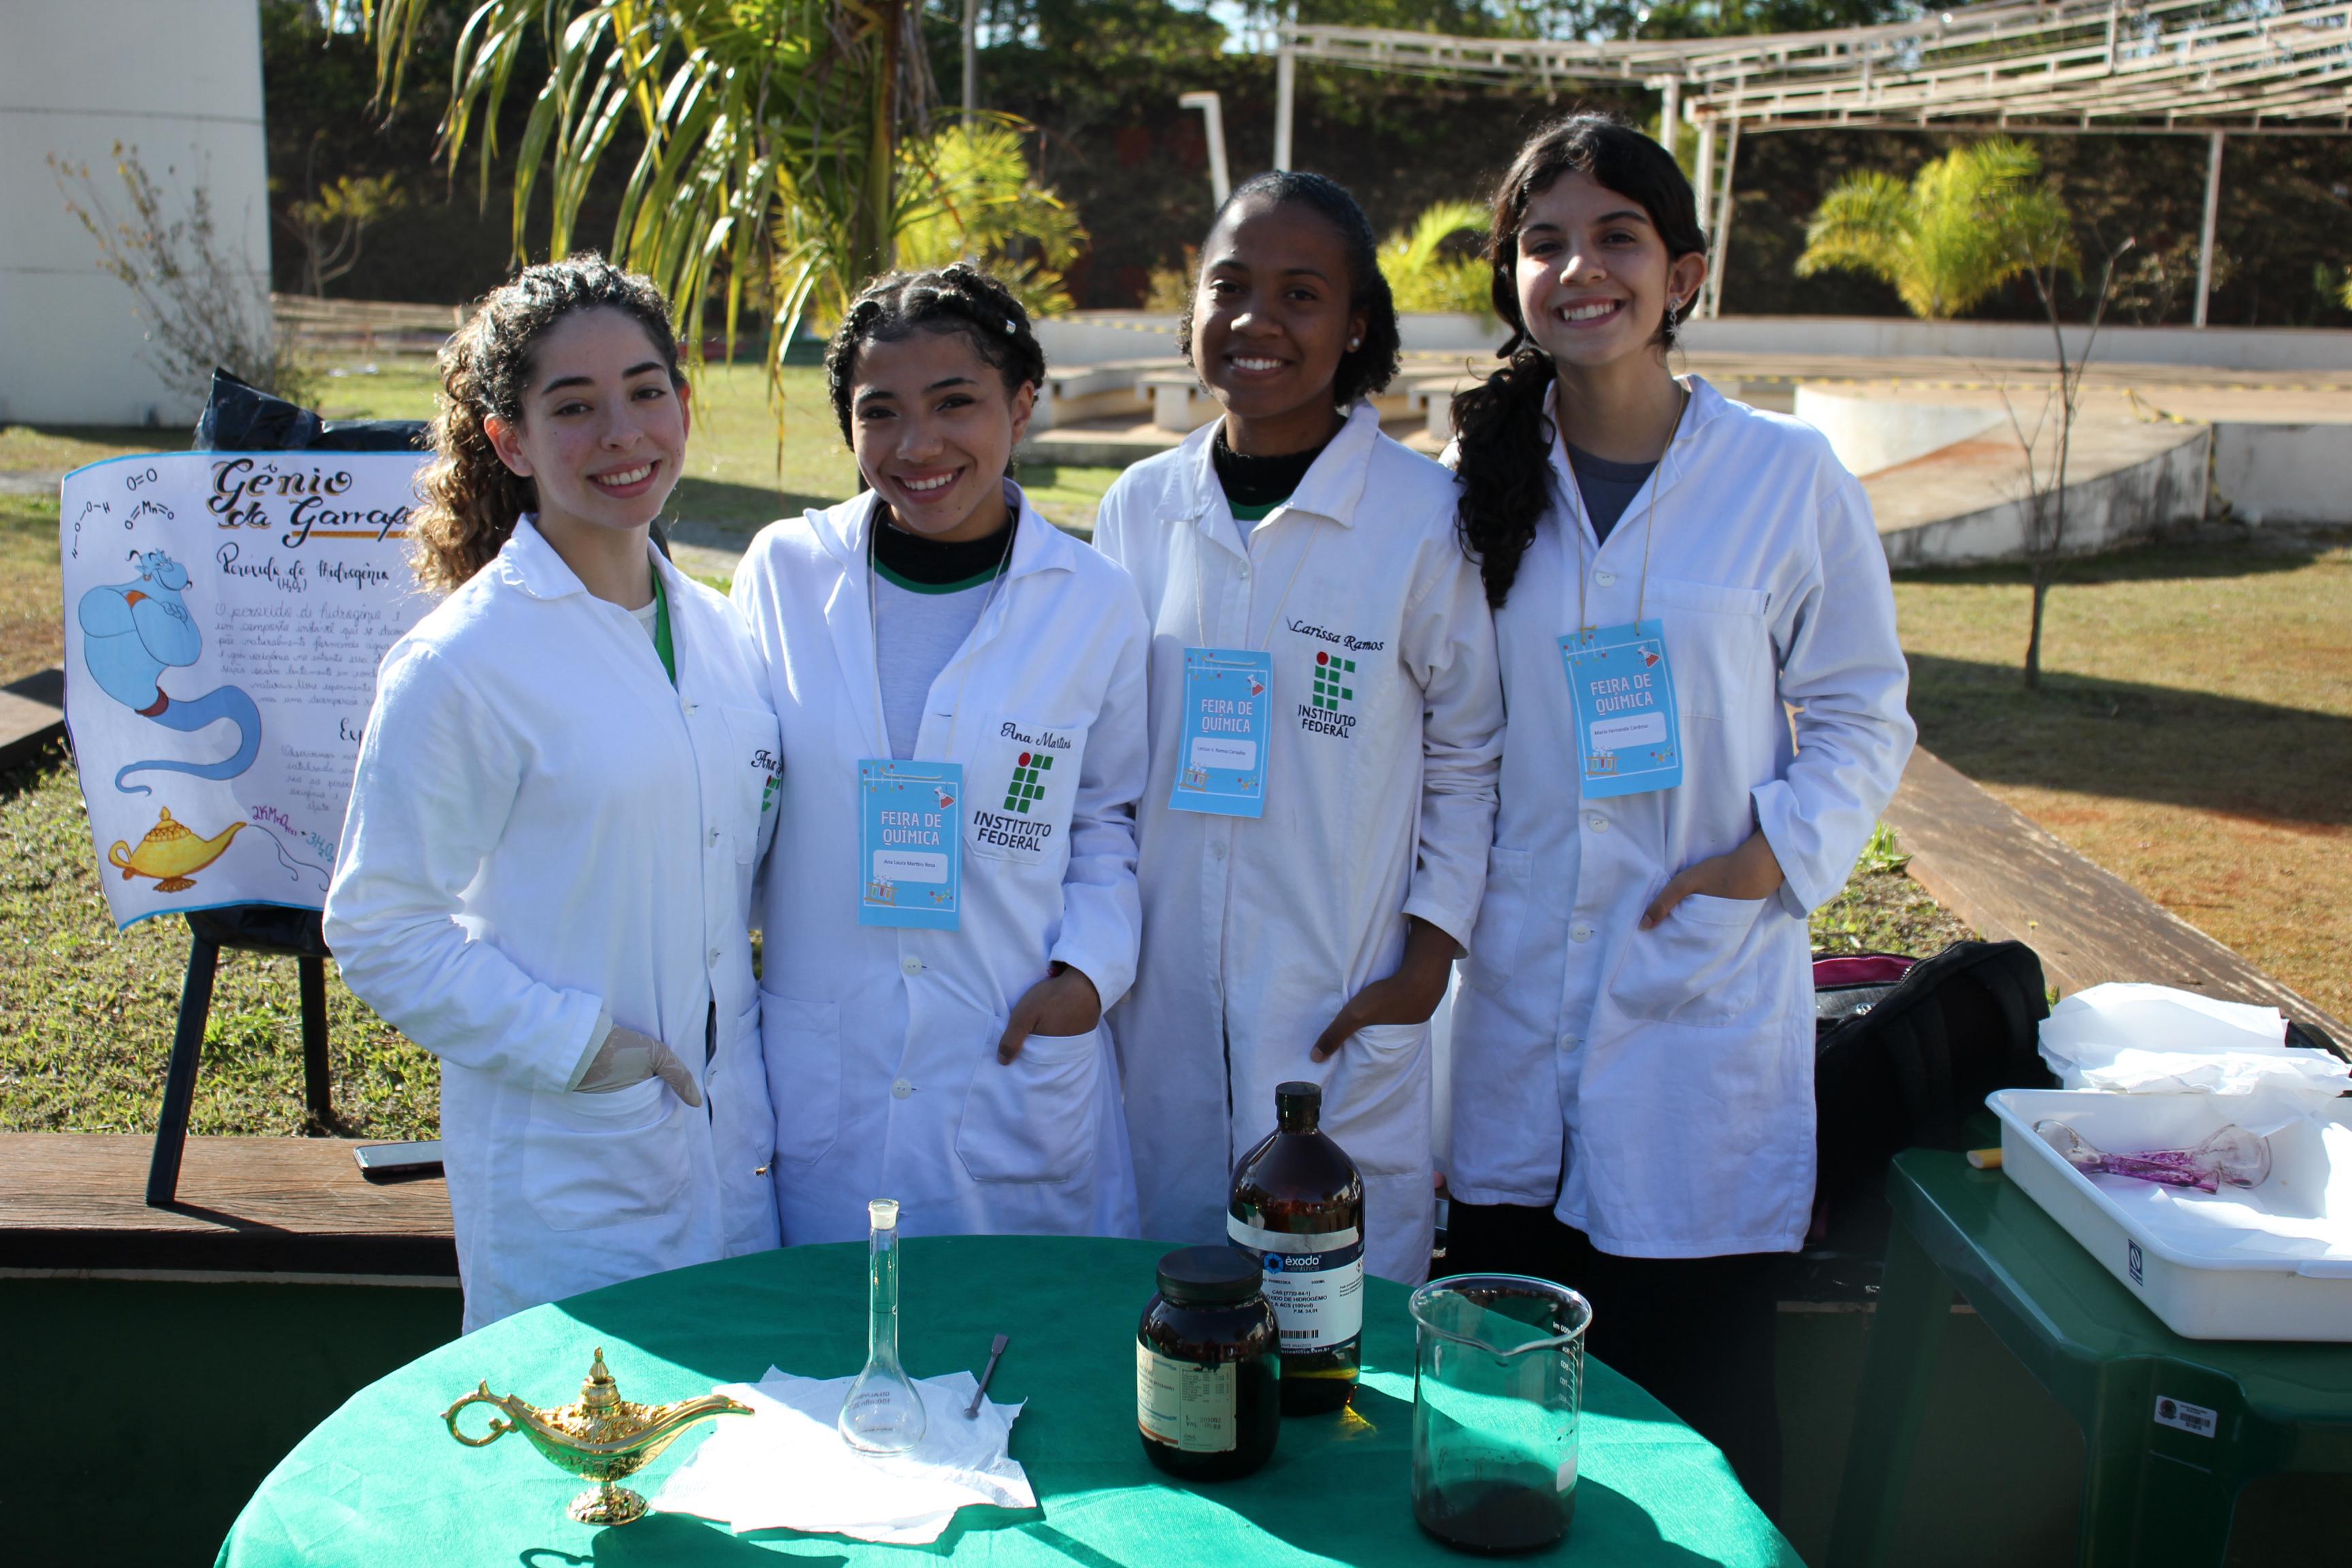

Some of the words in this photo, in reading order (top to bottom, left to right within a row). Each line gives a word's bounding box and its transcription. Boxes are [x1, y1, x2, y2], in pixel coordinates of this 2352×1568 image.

[206, 459, 353, 515] Gênio
[218, 501, 272, 529] da
[282, 496, 412, 548] Garraf
[1286, 616, 1341, 644] Larissa
[1343, 635, 1384, 651] Ramos
[1590, 676, 1630, 696] FEIRA
[1633, 673, 1653, 689] DE
[1201, 699, 1233, 714] FEIRA
[1238, 701, 1253, 715] DE
[1596, 691, 1654, 716] QUÍMICA
[1202, 714, 1250, 733] QUÍMICA
[1298, 704, 1356, 728] INSTITUTO
[1000, 722, 1033, 743] Ana
[1036, 732, 1071, 749] Martins
[1302, 719, 1350, 739] FEDERAL
[881, 811, 919, 827] FEIRA
[925, 813, 942, 828] DE
[974, 811, 1051, 838] INSTITUTO
[883, 826, 940, 846] QUÍMICA
[977, 828, 1041, 851] FEDERAL
[1285, 1256, 1319, 1266] êxodo
